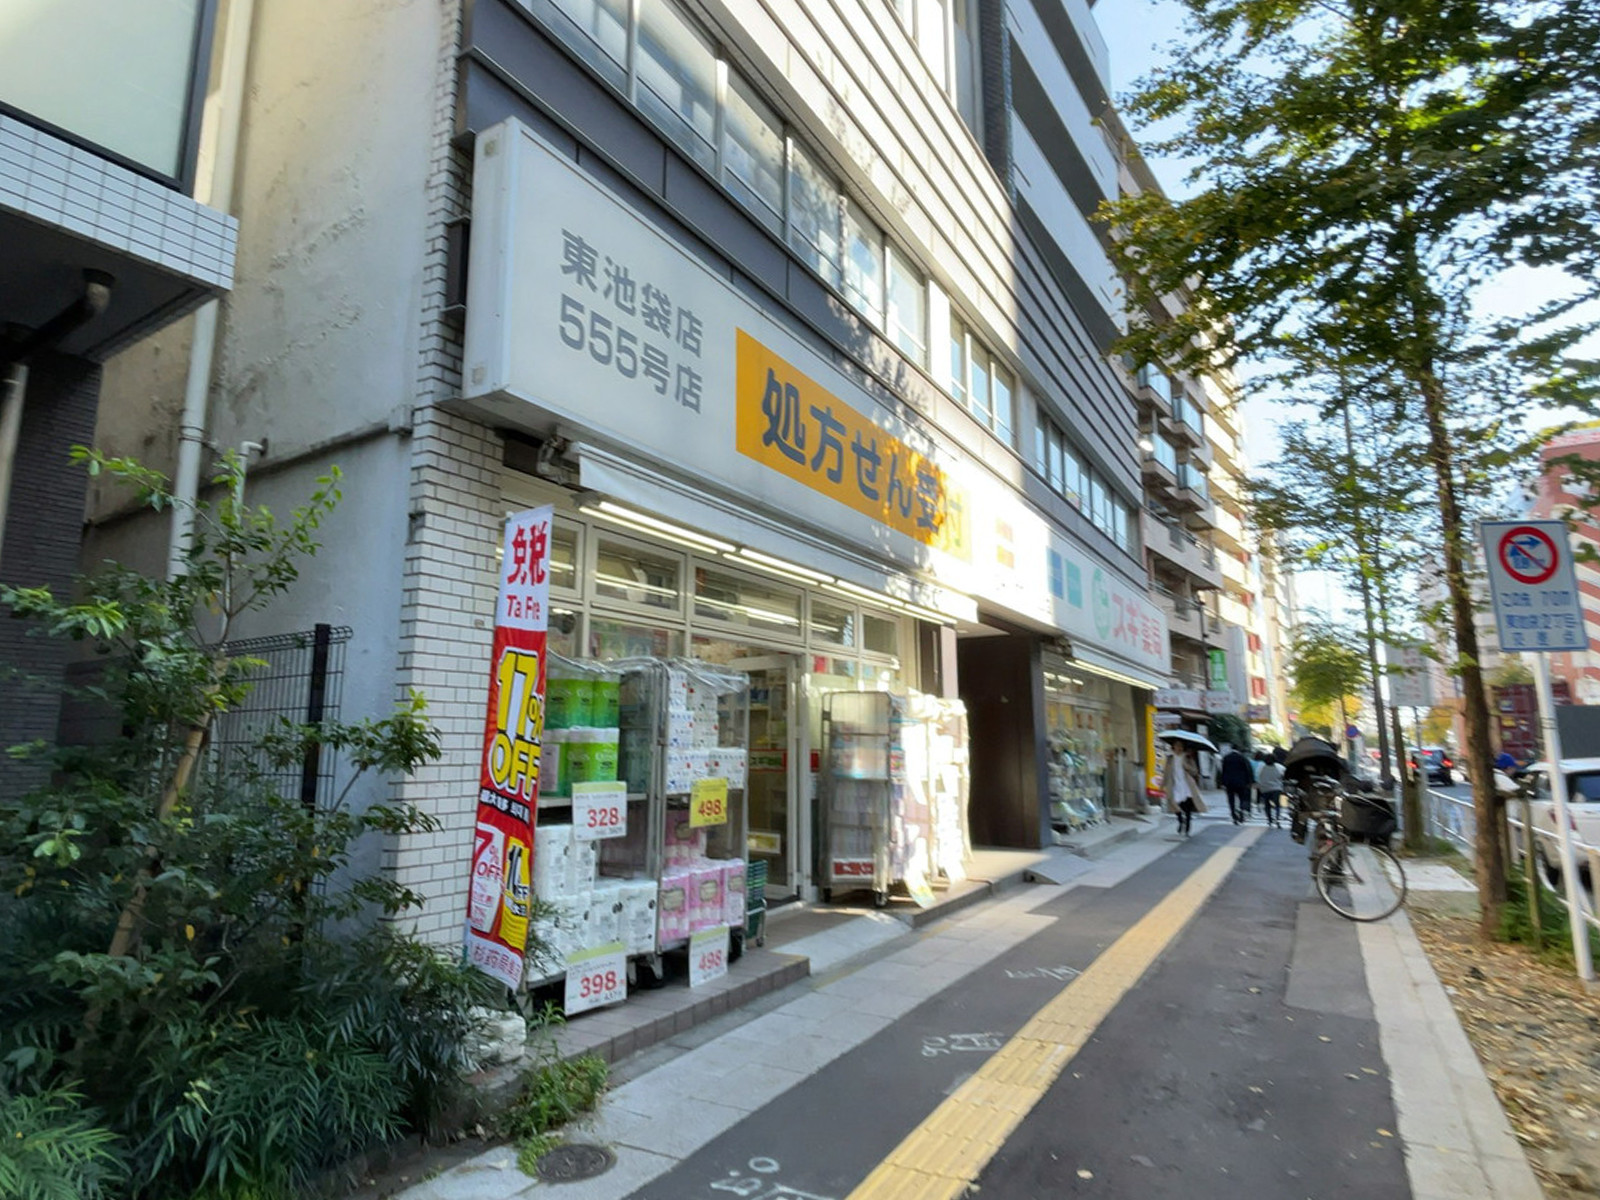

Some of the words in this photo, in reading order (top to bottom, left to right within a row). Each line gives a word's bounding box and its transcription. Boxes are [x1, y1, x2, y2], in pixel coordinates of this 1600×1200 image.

[560, 228, 704, 359] 東池袋店
[559, 294, 704, 414] 555号店
[587, 807, 620, 829] 328
[698, 799, 722, 817] 498
[699, 950, 722, 970] 498
[580, 971, 618, 999] 398
